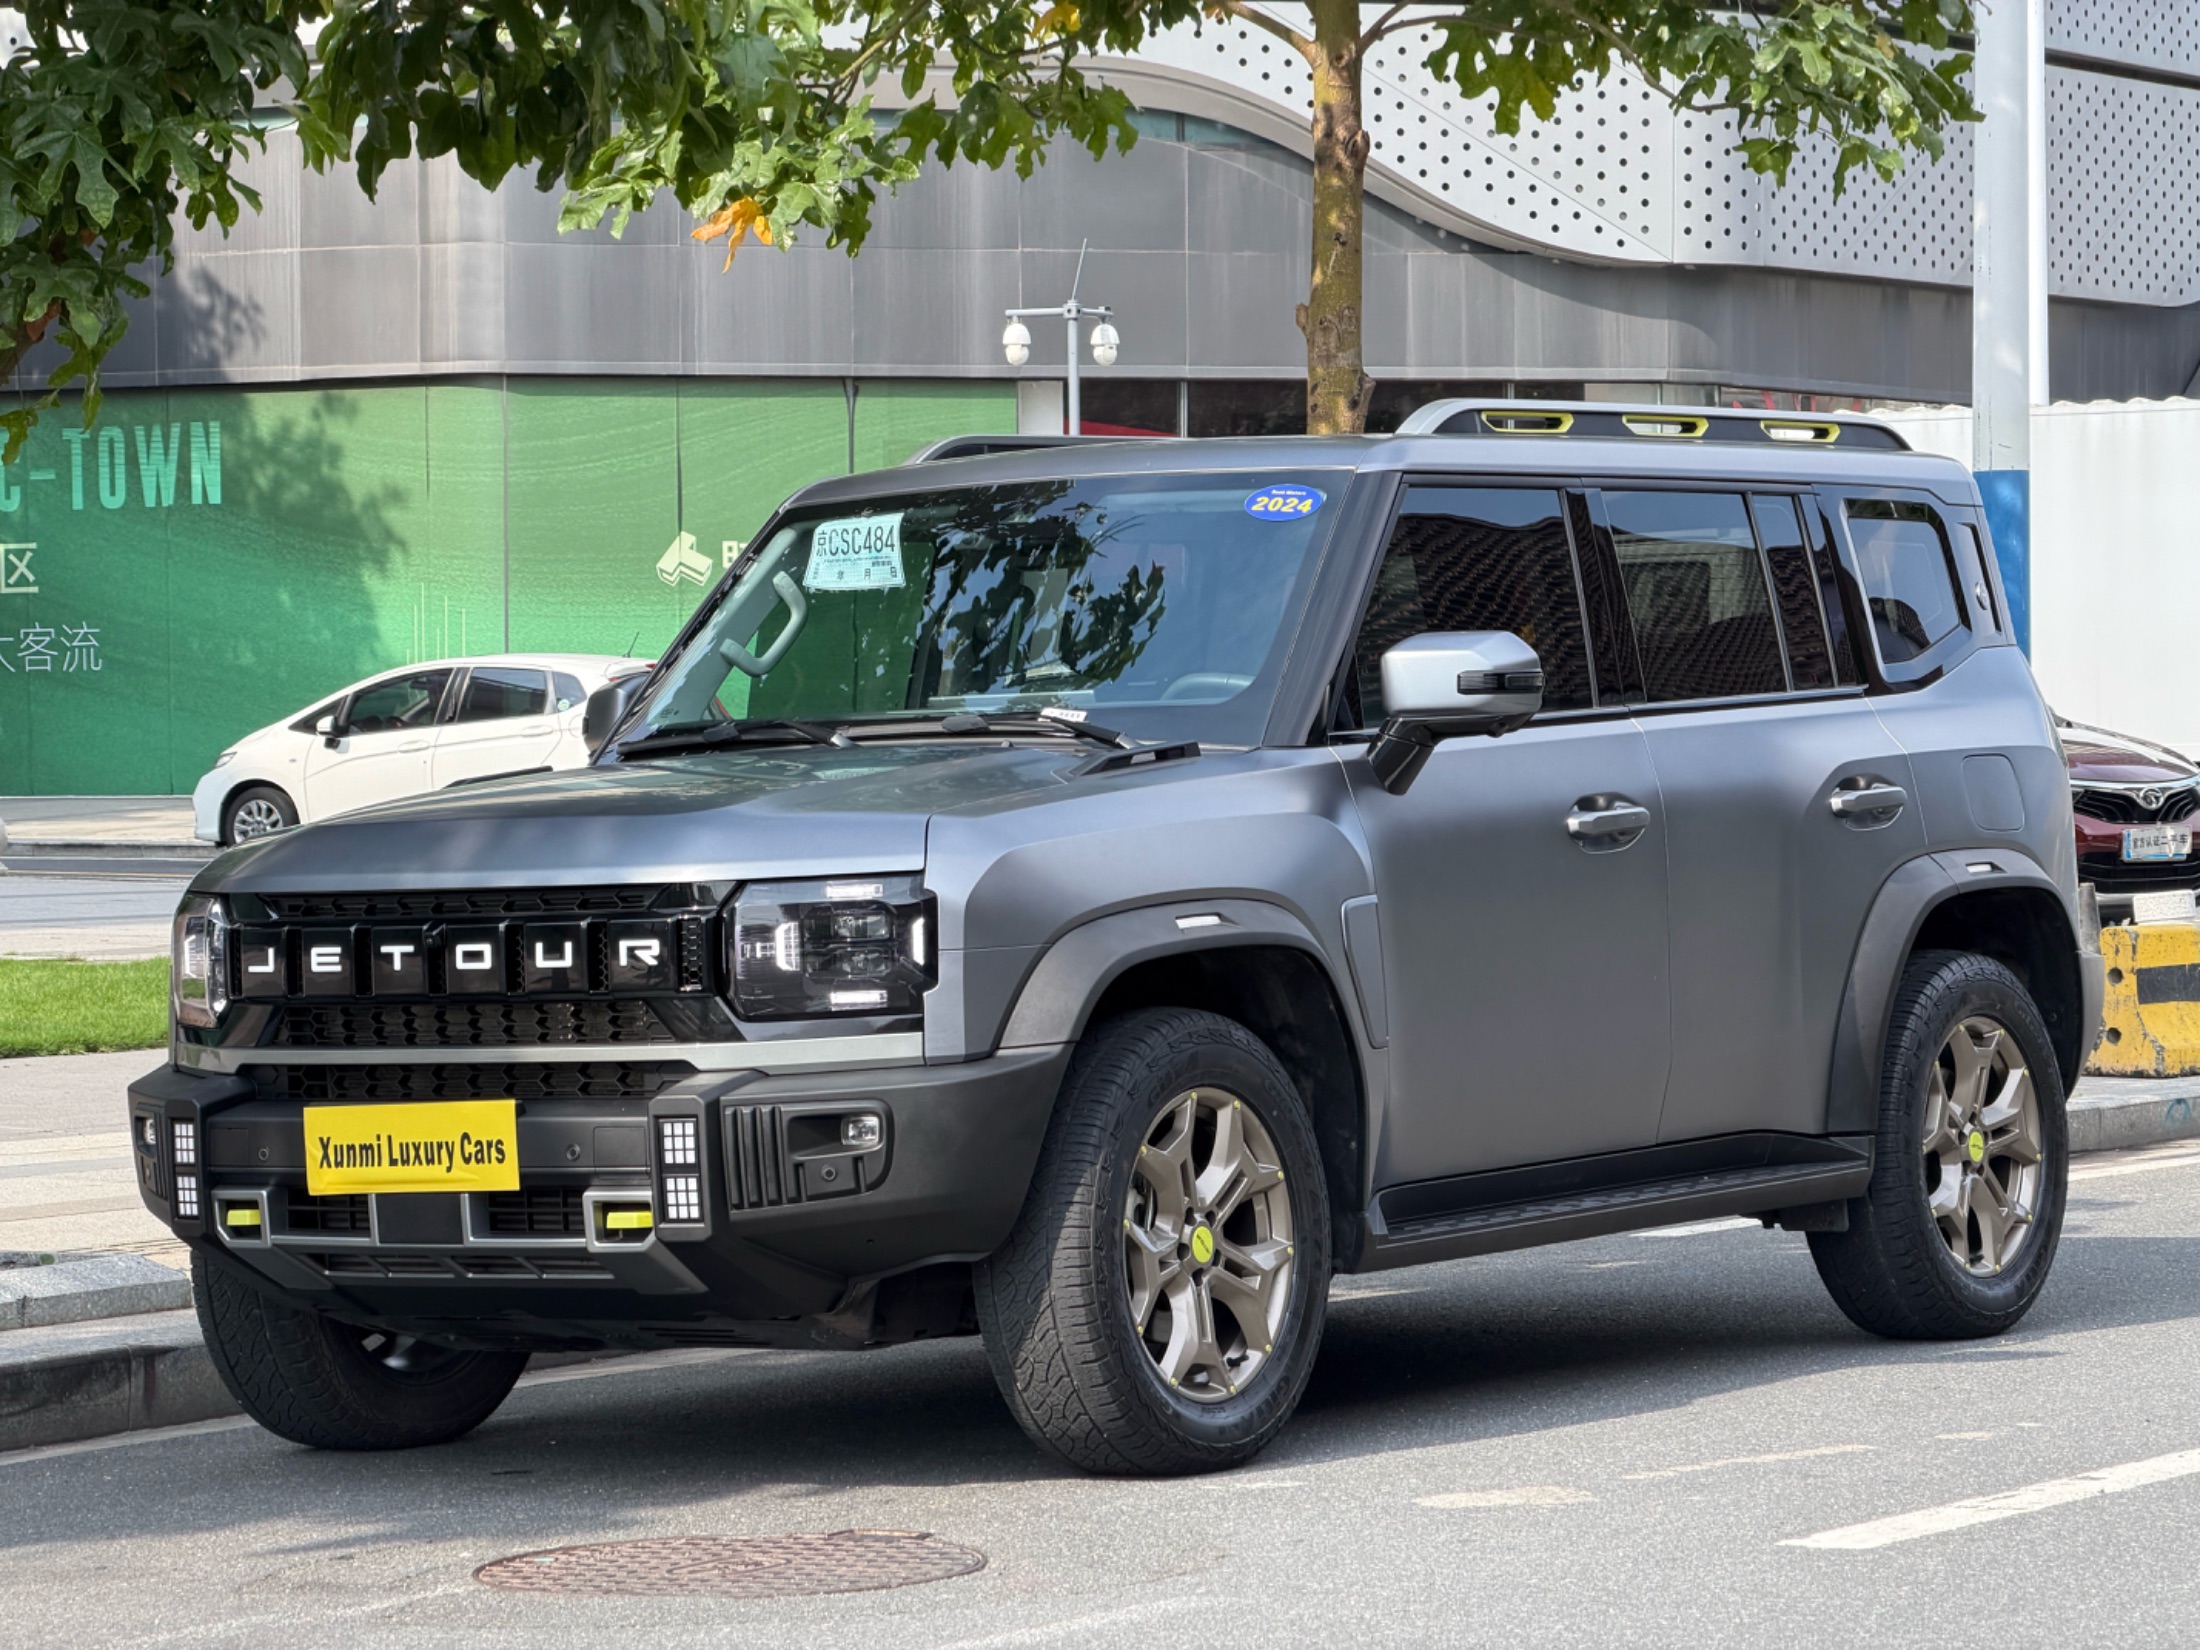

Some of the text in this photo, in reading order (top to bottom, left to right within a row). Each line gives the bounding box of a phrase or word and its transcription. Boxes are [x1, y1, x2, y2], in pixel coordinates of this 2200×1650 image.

[1251, 496, 1313, 514] 2024
[816, 525, 896, 557] 京CSC484
[0, 542, 39, 594] 区
[248, 938, 660, 973] JETOUR
[318, 1132, 506, 1173] Xunmi Luxury Cars
